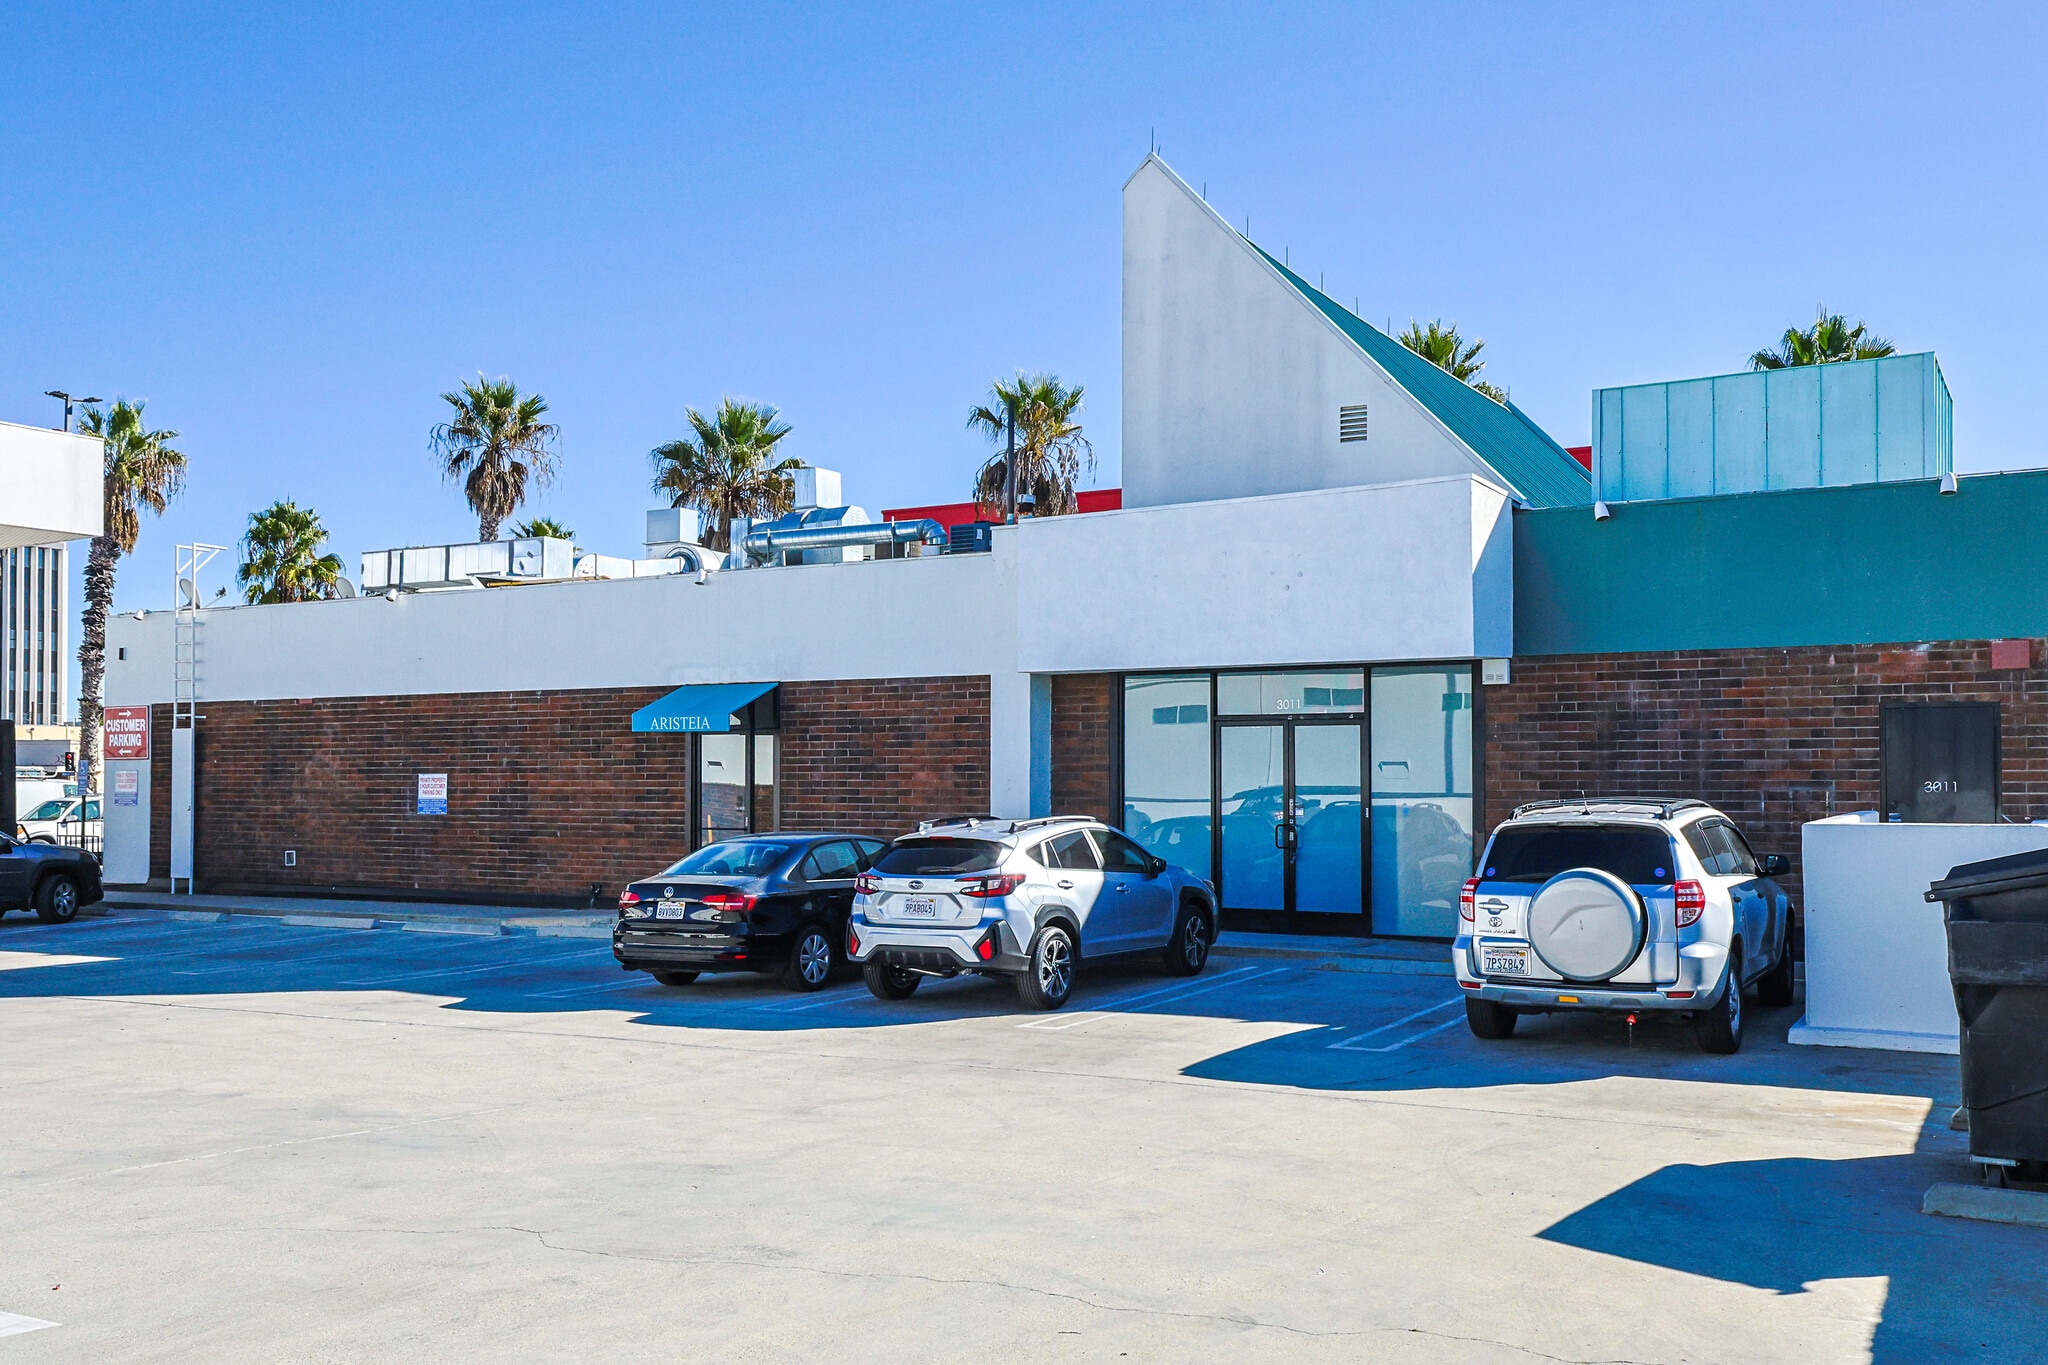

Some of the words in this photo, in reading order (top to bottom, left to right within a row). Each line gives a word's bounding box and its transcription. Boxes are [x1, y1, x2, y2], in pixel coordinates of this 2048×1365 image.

[1276, 699, 1300, 710] 3011
[105, 718, 146, 732] CUSTOMER
[650, 716, 711, 730] ARISTEIA
[109, 733, 142, 747] PARKING
[1924, 781, 1957, 793] 3011
[904, 903, 933, 914] 9PAB045
[1486, 958, 1525, 970] 7PSZ849
